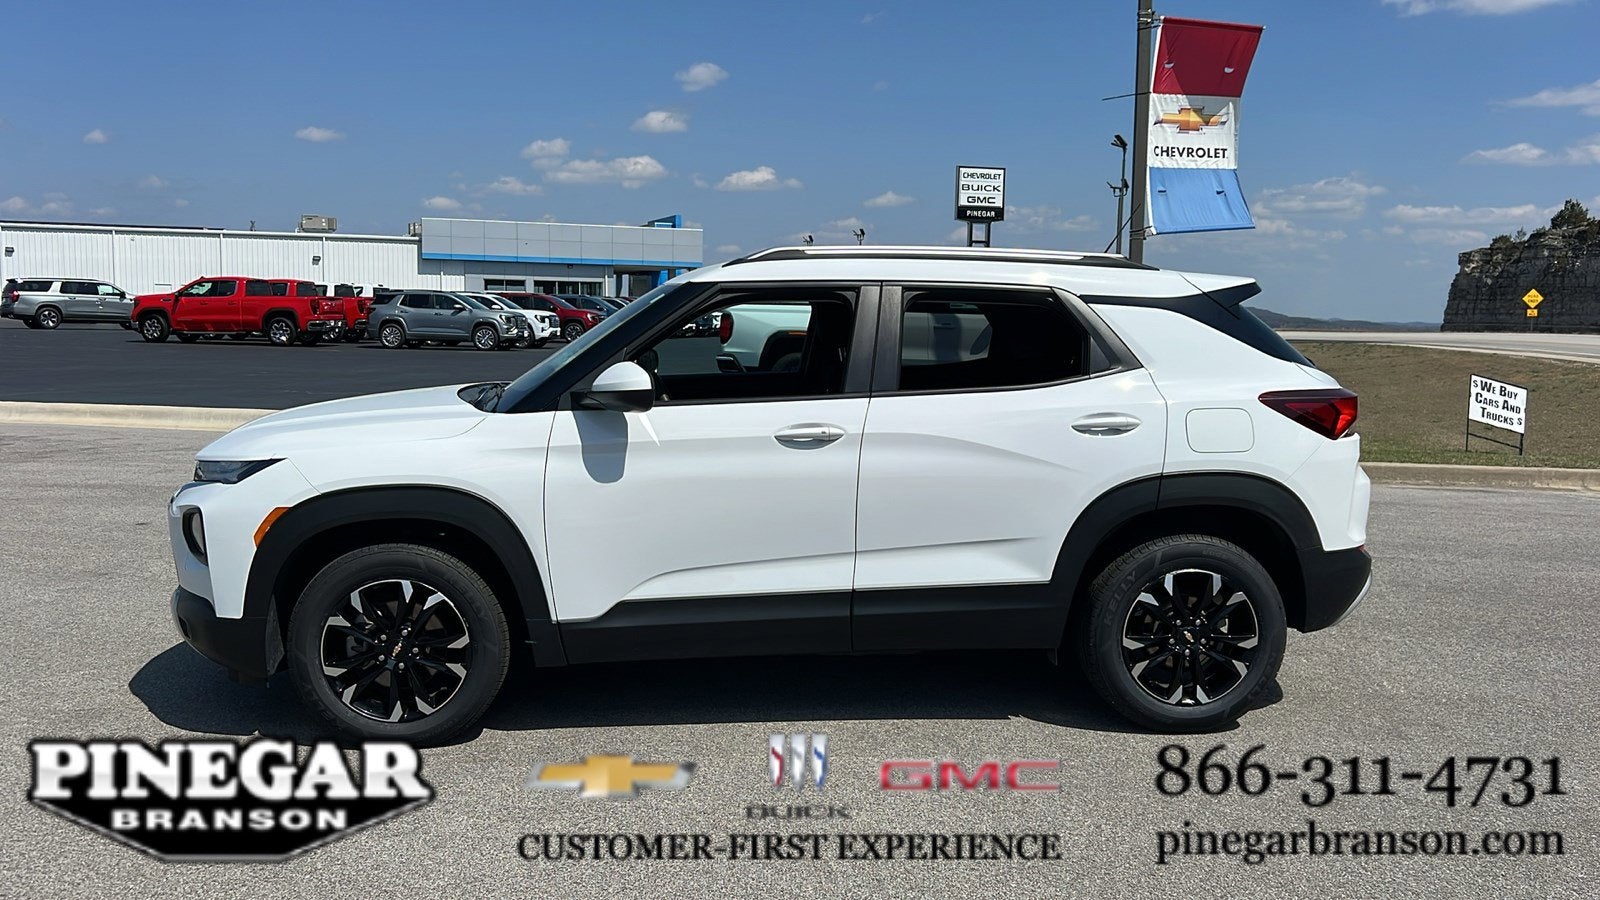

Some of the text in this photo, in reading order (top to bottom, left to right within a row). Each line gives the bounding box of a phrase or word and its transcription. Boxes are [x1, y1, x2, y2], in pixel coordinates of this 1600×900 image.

[1153, 145, 1228, 159] CHEVROLET
[962, 171, 1002, 180] CHEVROLET
[961, 183, 1002, 193] BUICK
[966, 195, 996, 205] GMC
[966, 210, 996, 218] PINEGAR
